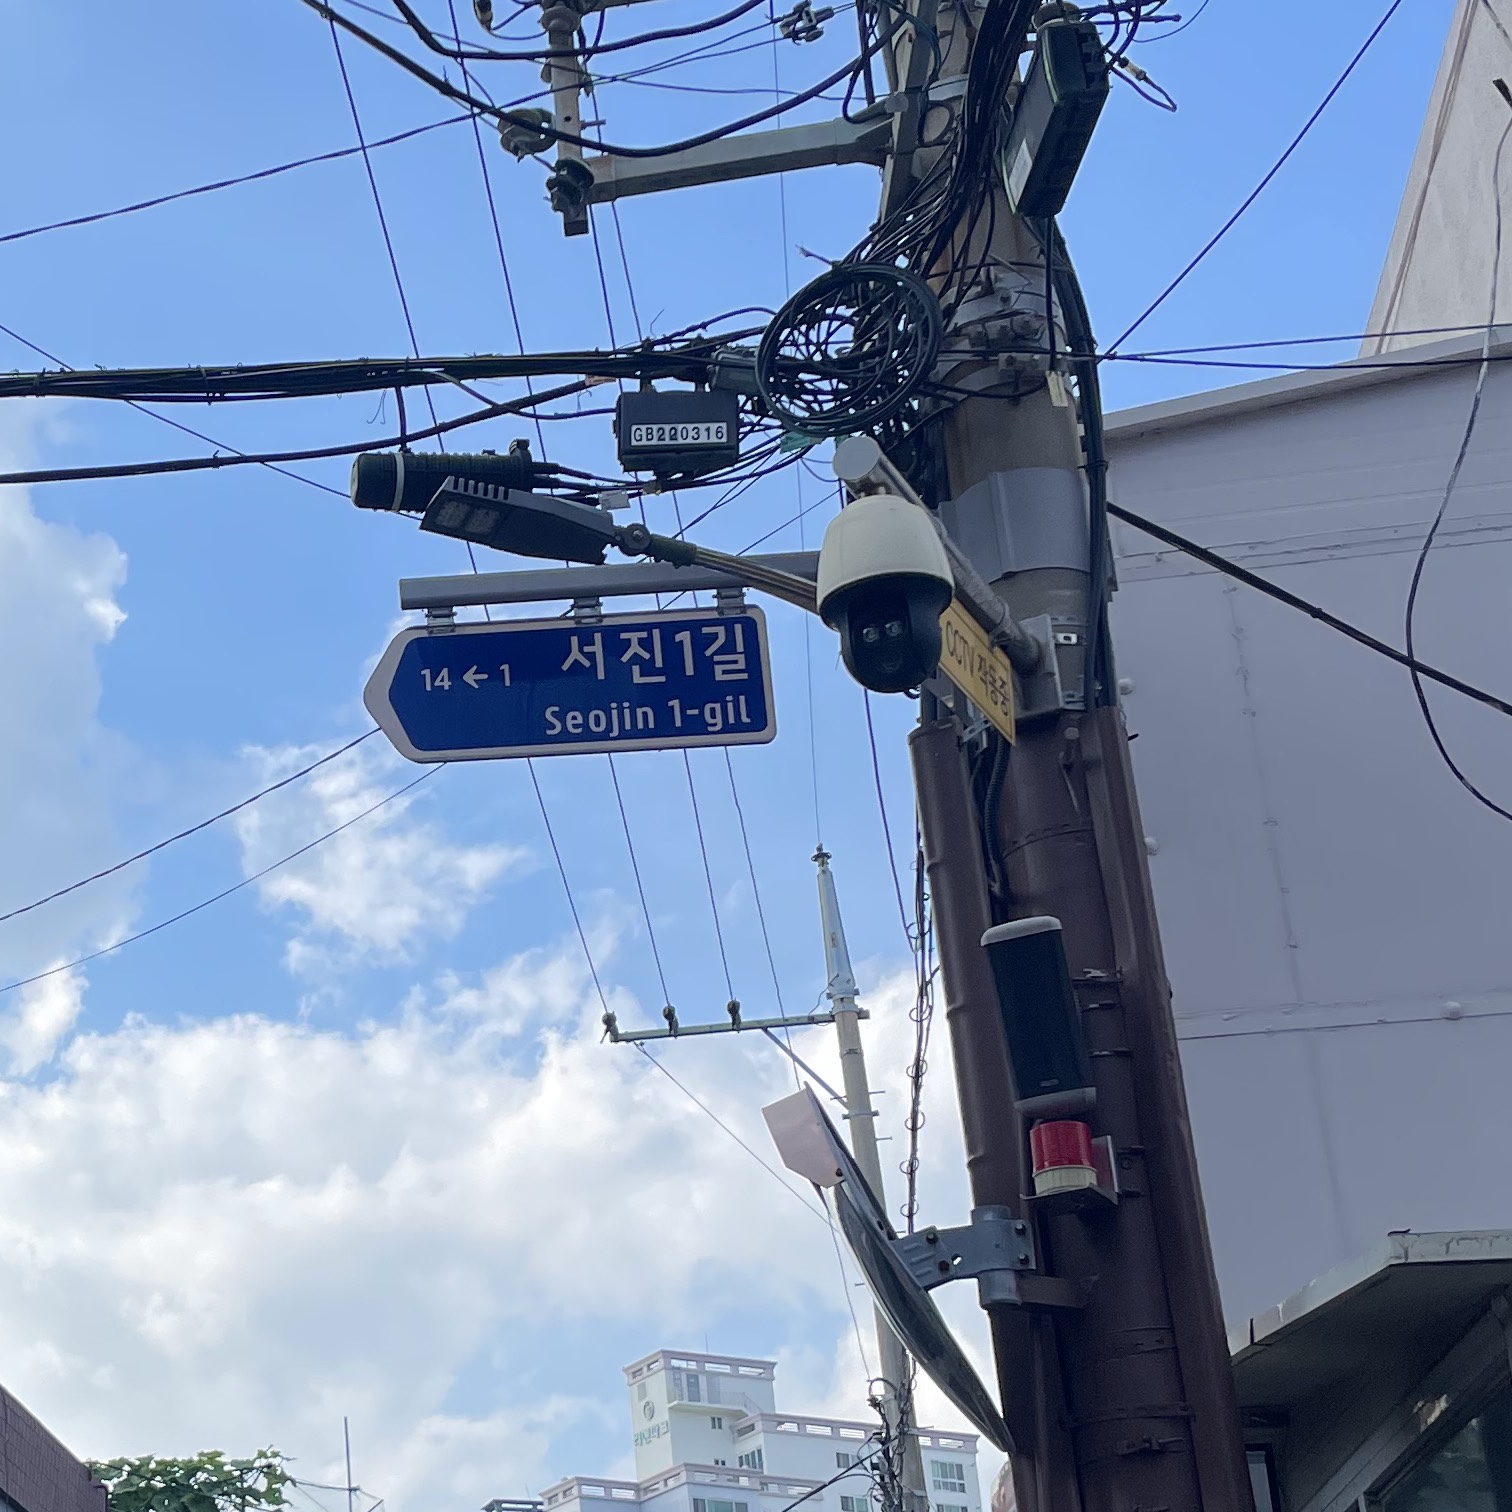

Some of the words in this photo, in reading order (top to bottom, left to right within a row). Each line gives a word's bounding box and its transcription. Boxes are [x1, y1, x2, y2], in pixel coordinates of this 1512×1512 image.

[561, 623, 749, 684] 서진1길
[945, 620, 975, 679] CCTV
[420, 667, 452, 692] 14
[499, 664, 512, 687] 1
[545, 703, 655, 737] Seojin
[668, 696, 751, 732] 1-gil
